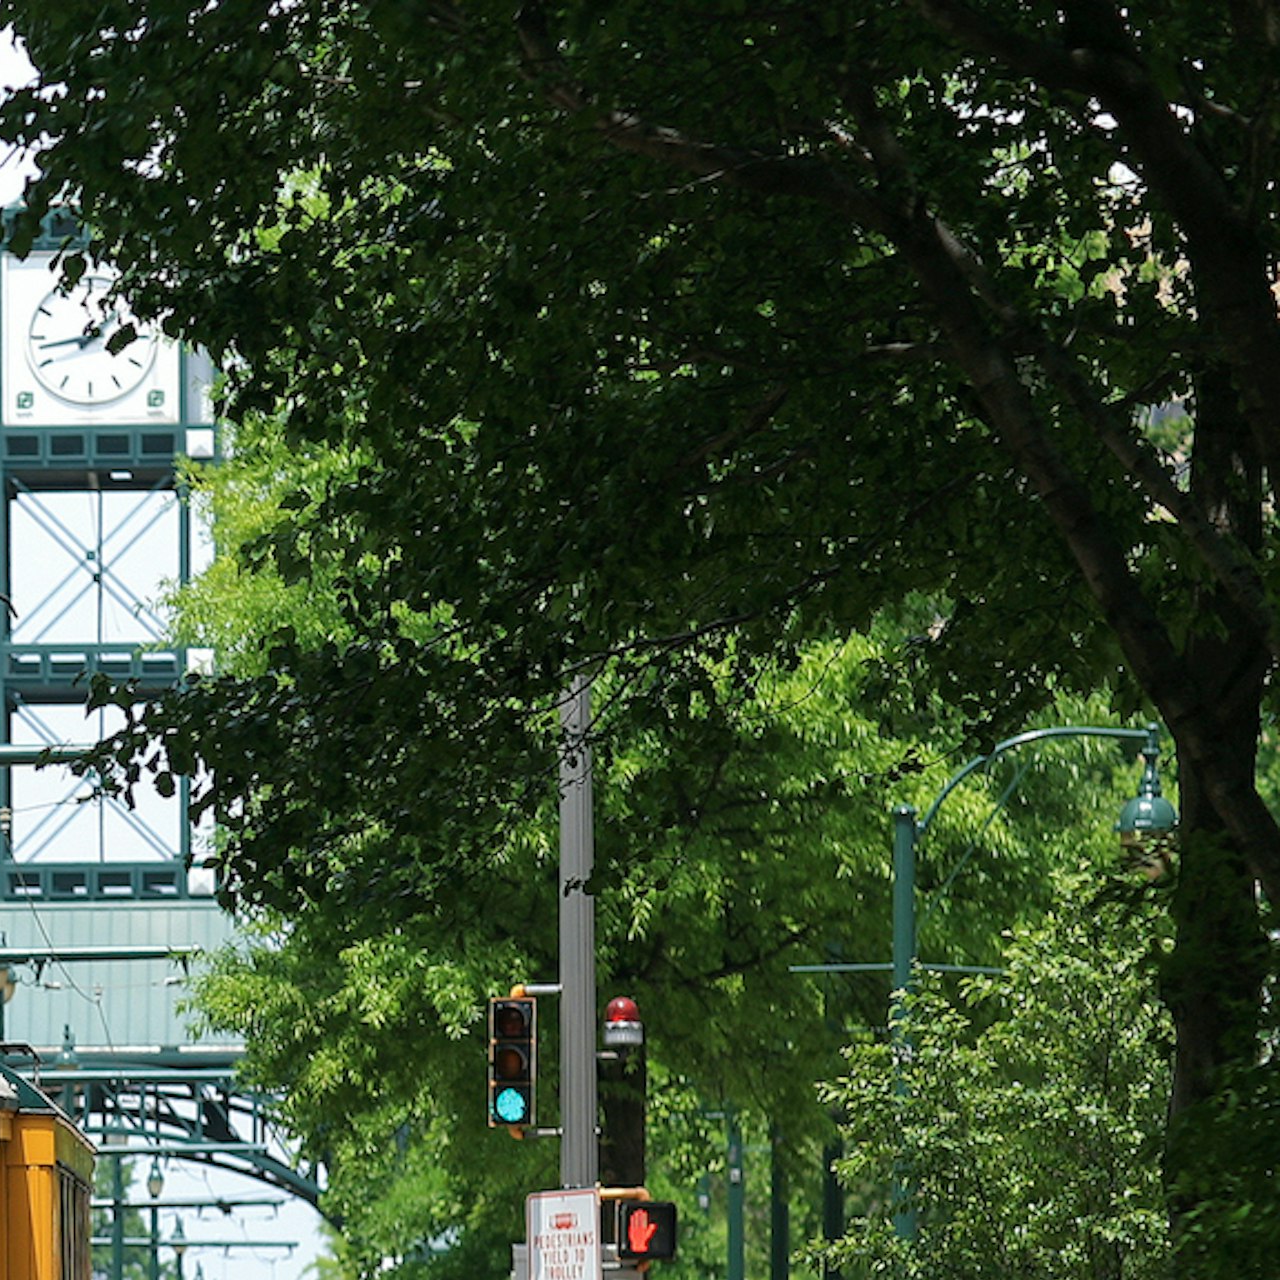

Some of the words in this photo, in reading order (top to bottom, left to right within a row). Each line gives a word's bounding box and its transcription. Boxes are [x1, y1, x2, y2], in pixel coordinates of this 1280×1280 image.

[534, 1232, 593, 1249] PEDESTRIANS
[544, 1250, 569, 1264] YIELD
[575, 1248, 585, 1262] TO
[544, 1264, 582, 1280] TROLLEY
